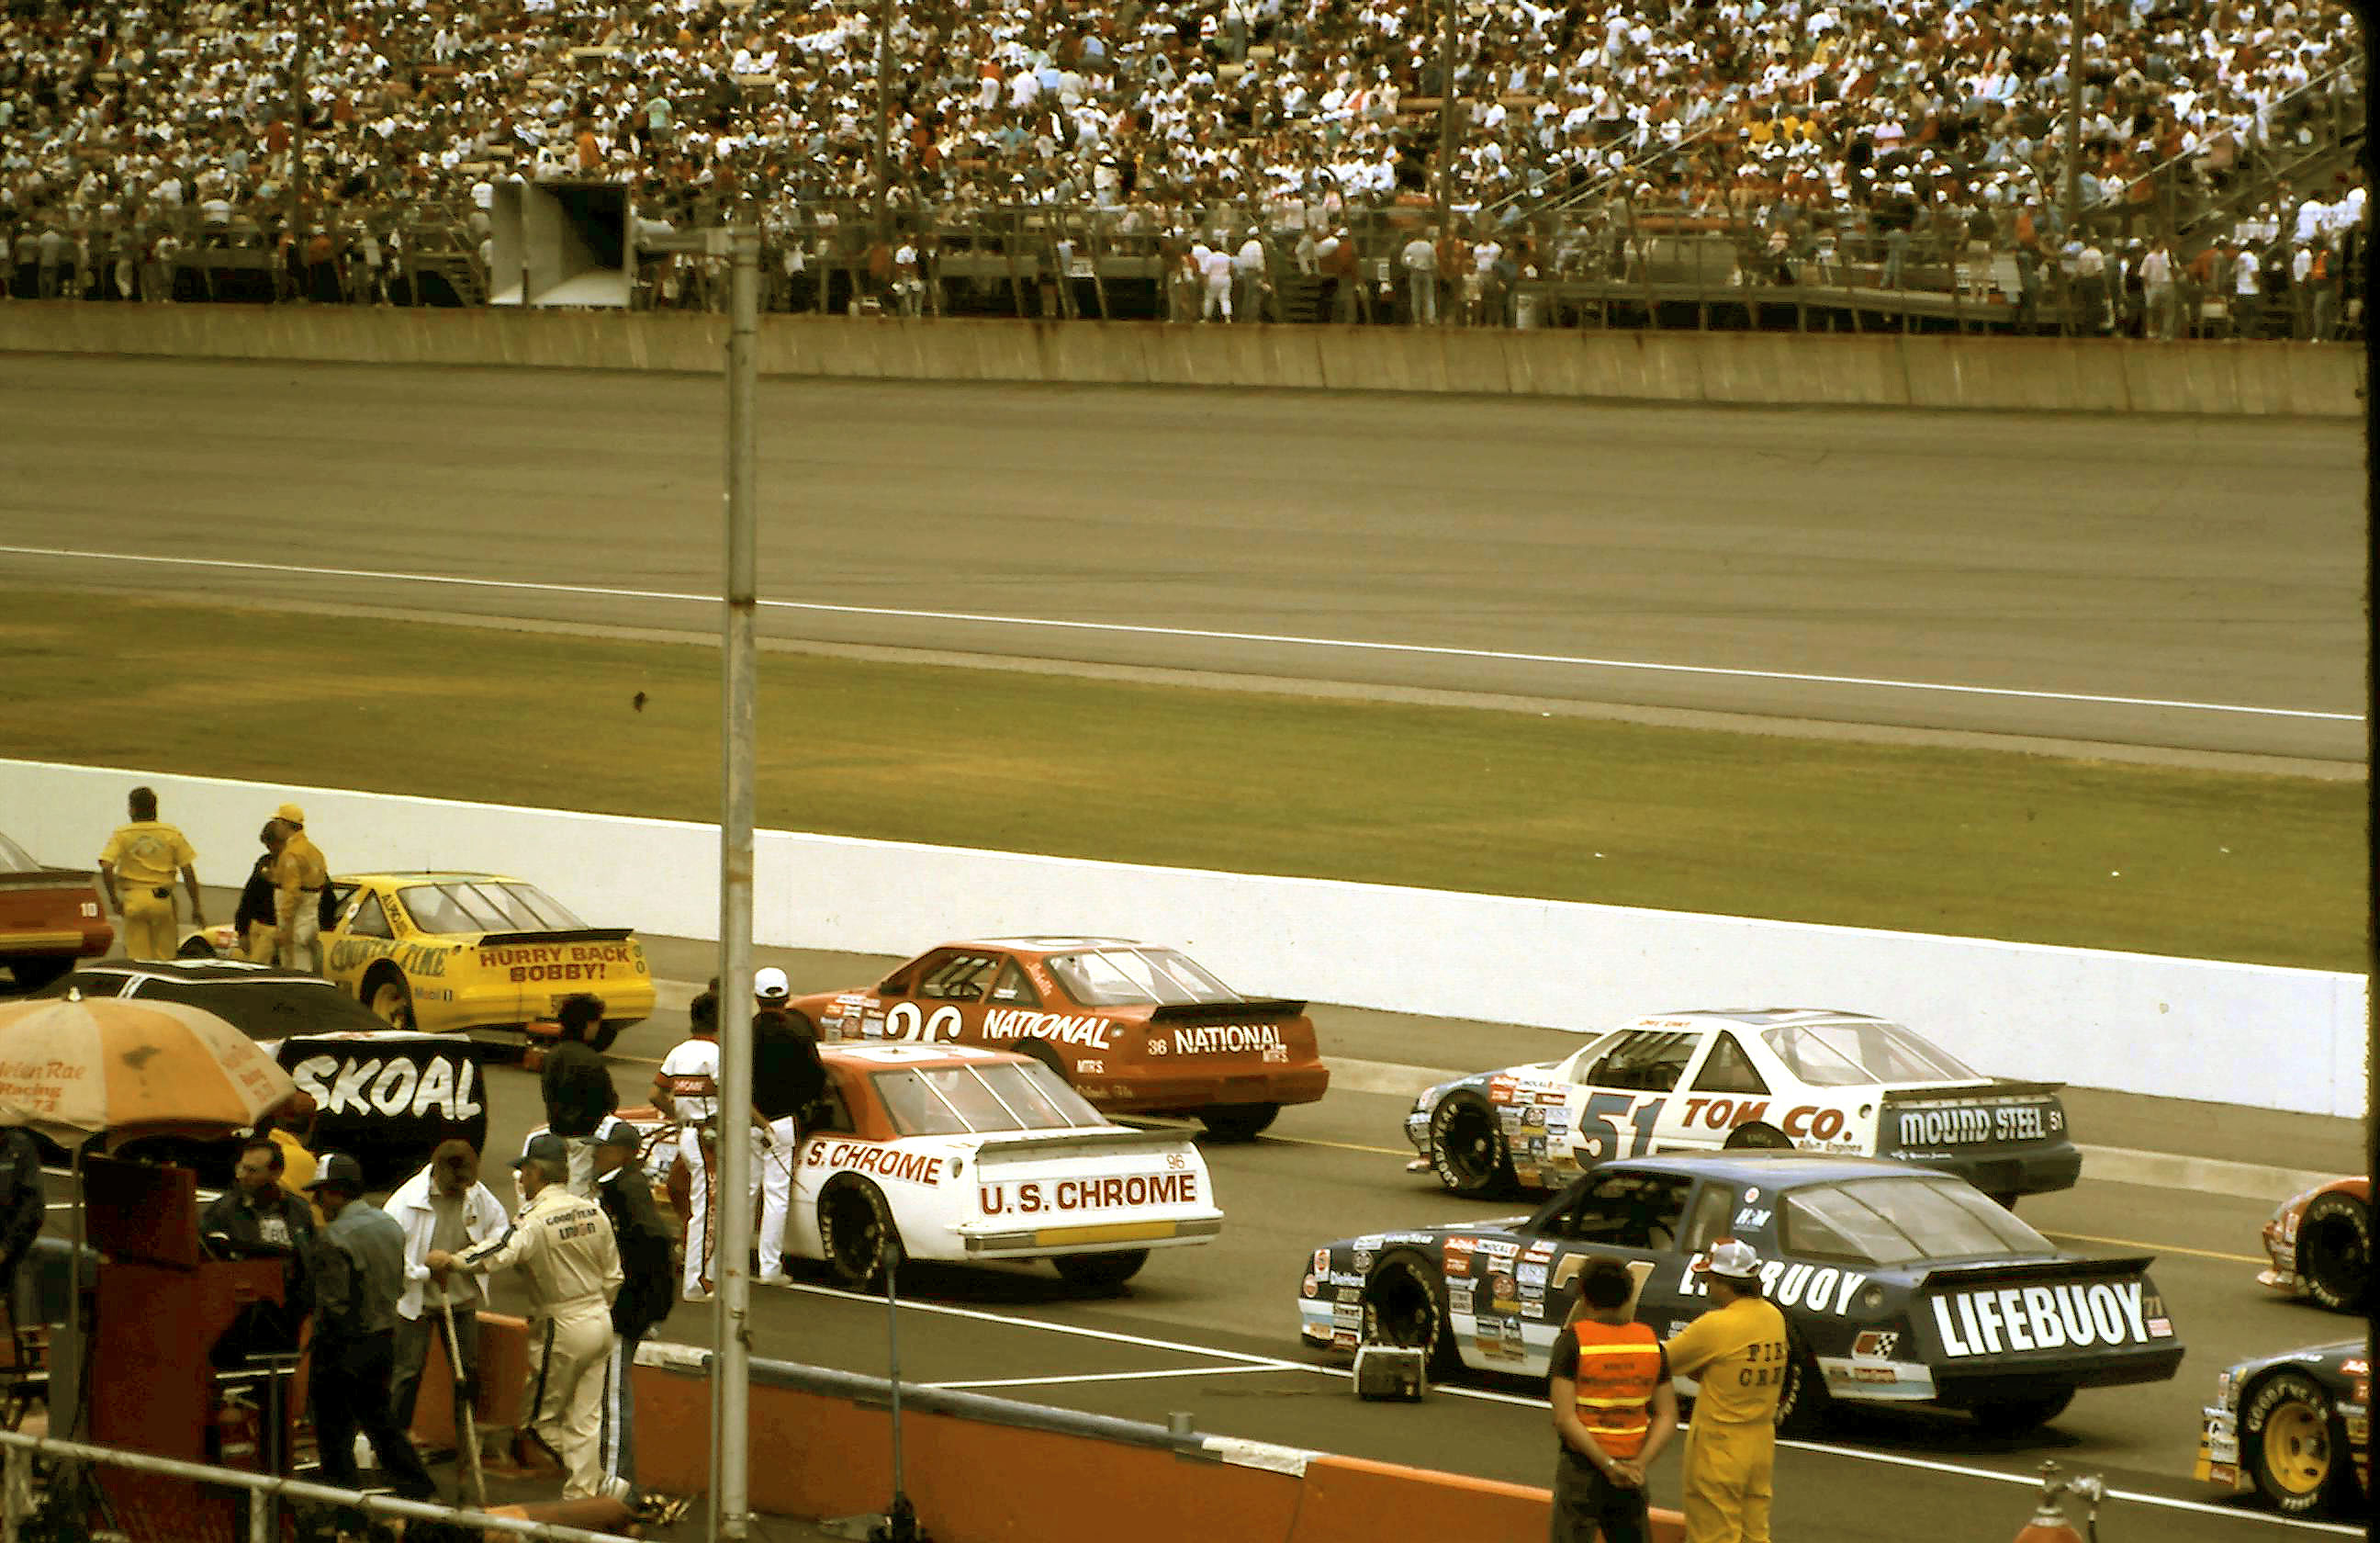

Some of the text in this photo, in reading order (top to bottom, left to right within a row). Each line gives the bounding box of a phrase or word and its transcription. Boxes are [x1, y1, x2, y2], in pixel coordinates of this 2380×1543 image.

[479, 946, 631, 967] HURRY BACK
[510, 963, 606, 983] BOBBY!
[982, 1008, 1109, 1050] NATIONAL
[1148, 1024, 1282, 1056] 36 NATIONAL
[292, 1055, 482, 1121] SKOAL
[1574, 1093, 1667, 1173] 51
[1681, 1098, 1853, 1142] TOM CO.
[1899, 1109, 1992, 1146] MOUND
[1995, 1107, 2047, 1141] STEEL
[830, 1144, 942, 1186] CHROME
[1057, 1174, 1196, 1211] CHROME
[1931, 1282, 2149, 1357] LIFEBUOY
[1746, 1342, 1783, 1362] FIR
